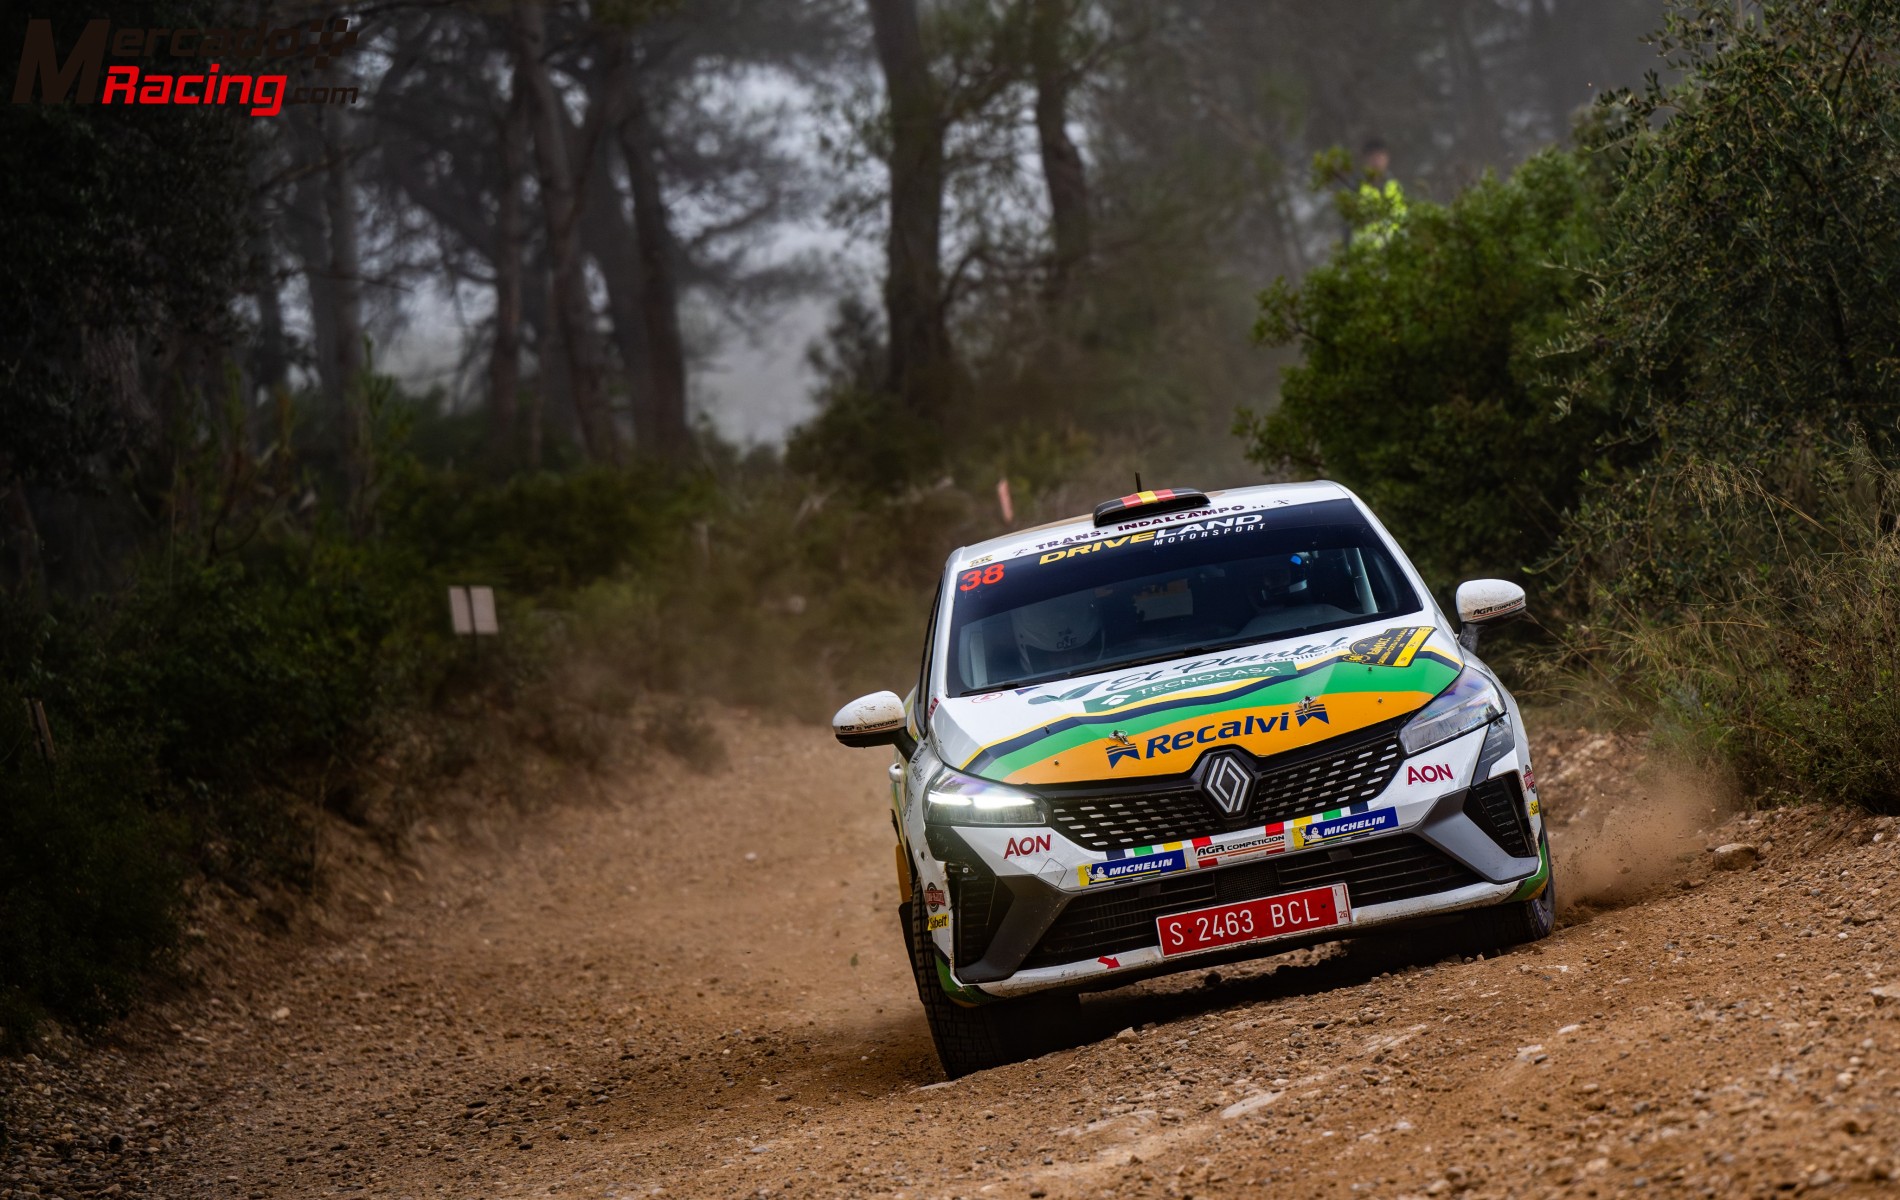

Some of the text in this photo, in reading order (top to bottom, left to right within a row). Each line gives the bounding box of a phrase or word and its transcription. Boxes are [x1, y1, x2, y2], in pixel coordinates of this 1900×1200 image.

[1035, 530, 1108, 550] TRANS.
[1118, 505, 1245, 531] INDALCAMPO
[1039, 514, 1263, 565] DRIVELAND
[1153, 522, 1266, 547] MOTORSPORT
[959, 563, 1005, 592] 38
[1473, 606, 1493, 616] AGR
[1173, 636, 1348, 674] Plantel
[1136, 666, 1281, 695] TECNOCASA
[1145, 712, 1290, 759] Recalvi
[1407, 763, 1454, 786] AON
[1323, 815, 1386, 836] MICHELIN
[1003, 834, 1052, 860] AON
[1197, 835, 1285, 857] AGR COMPETICION
[1108, 857, 1174, 877] MICHELIN
[1169, 898, 1320, 947] S 2463 BCL
